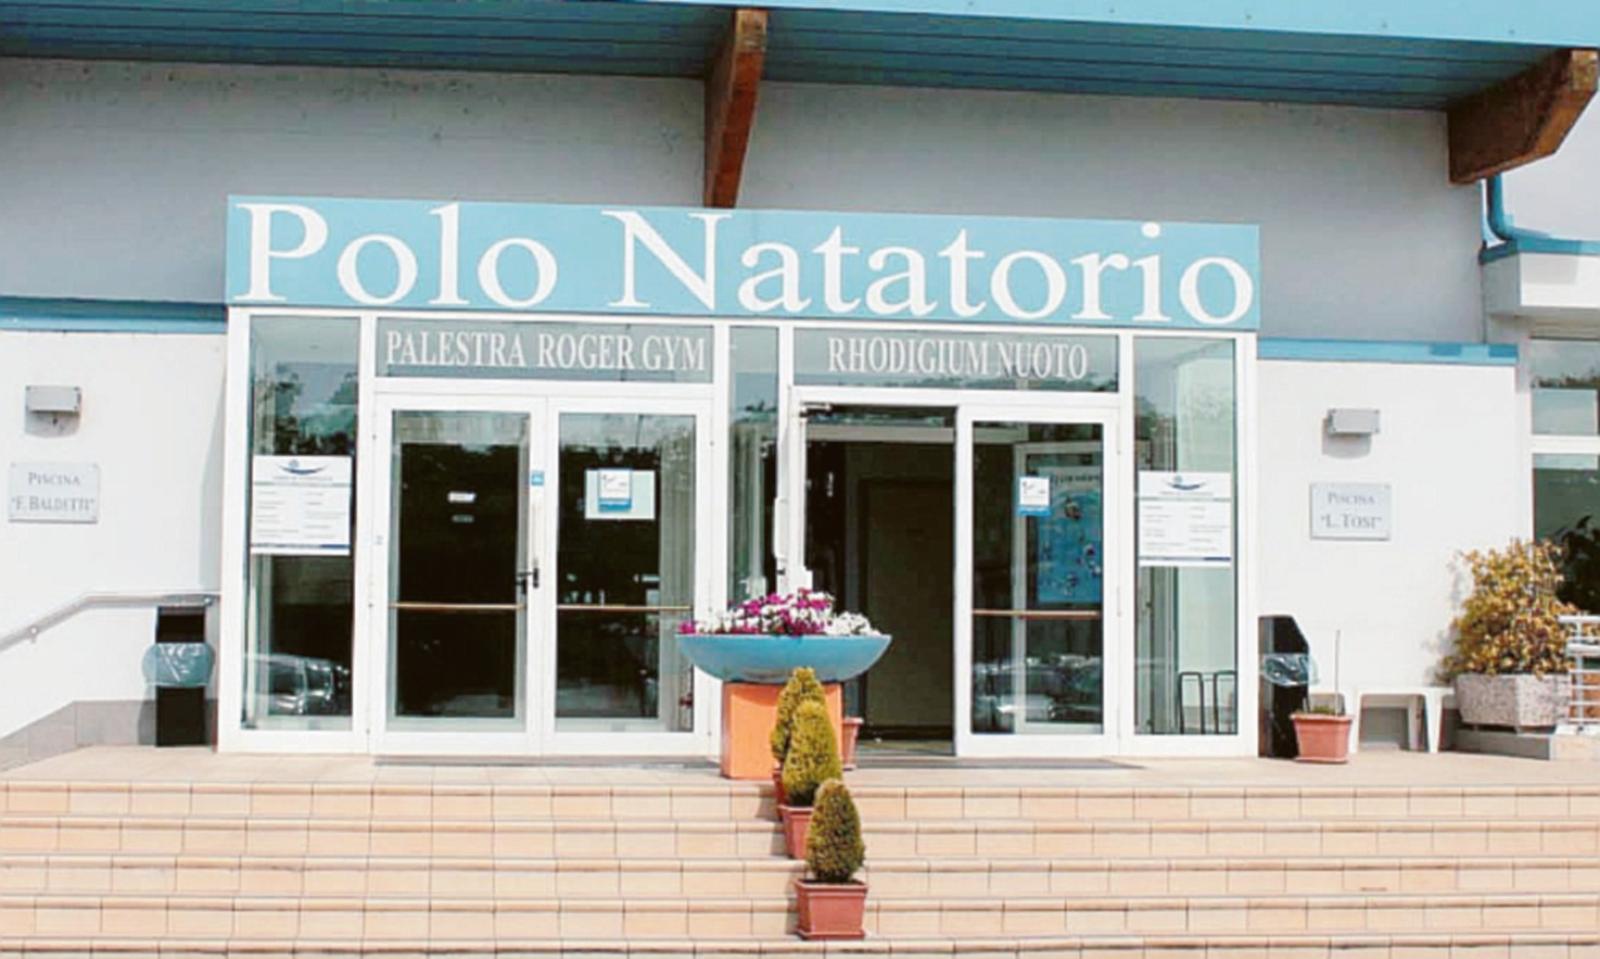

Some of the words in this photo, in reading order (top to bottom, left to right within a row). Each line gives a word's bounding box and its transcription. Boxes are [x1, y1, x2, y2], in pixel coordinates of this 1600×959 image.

[233, 201, 558, 308] Polo
[602, 210, 1254, 325] Natatorio
[386, 330, 527, 368] PALESTRA
[537, 334, 635, 371] ROGER
[642, 335, 706, 372] GYM
[828, 337, 990, 376] RHODIGIUM
[996, 342, 1089, 380] NUOTO
